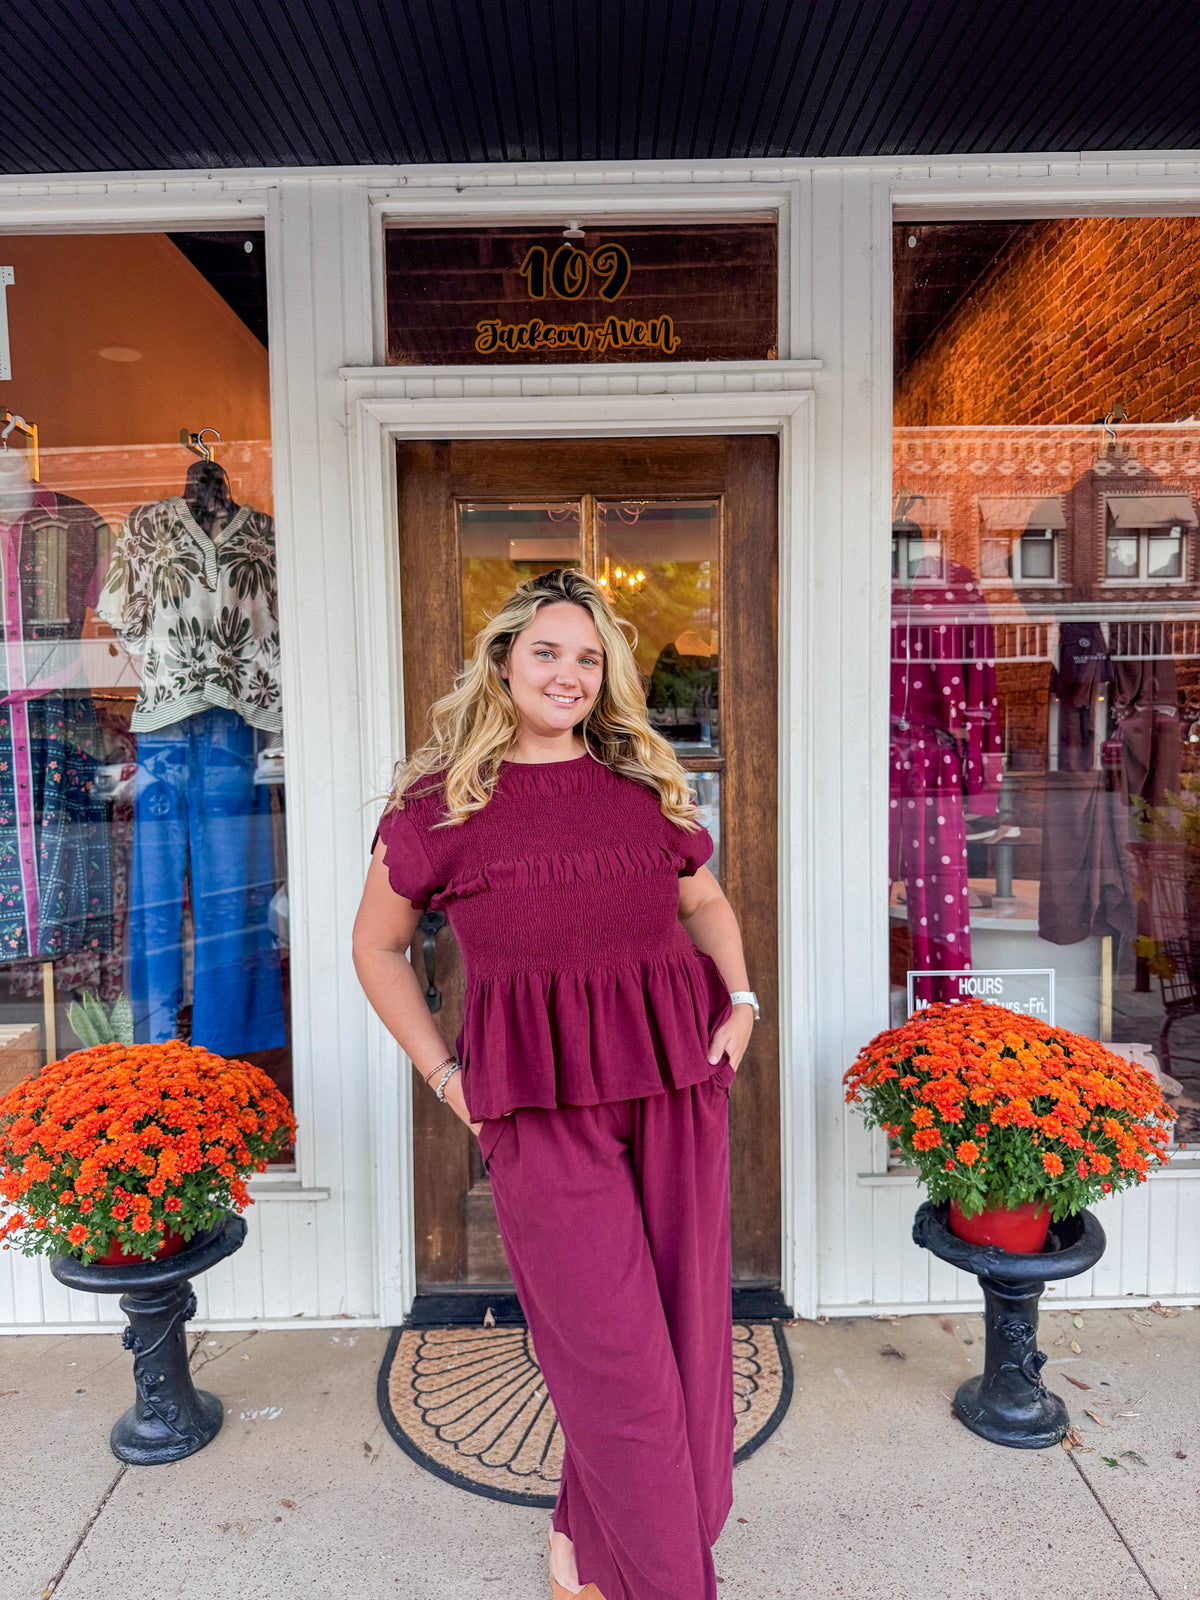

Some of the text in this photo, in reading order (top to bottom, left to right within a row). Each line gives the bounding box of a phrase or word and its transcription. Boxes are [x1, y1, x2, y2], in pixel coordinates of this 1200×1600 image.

[520, 243, 631, 303] 109
[475, 318, 593, 354] Jackson
[959, 977, 1003, 995] HOURS
